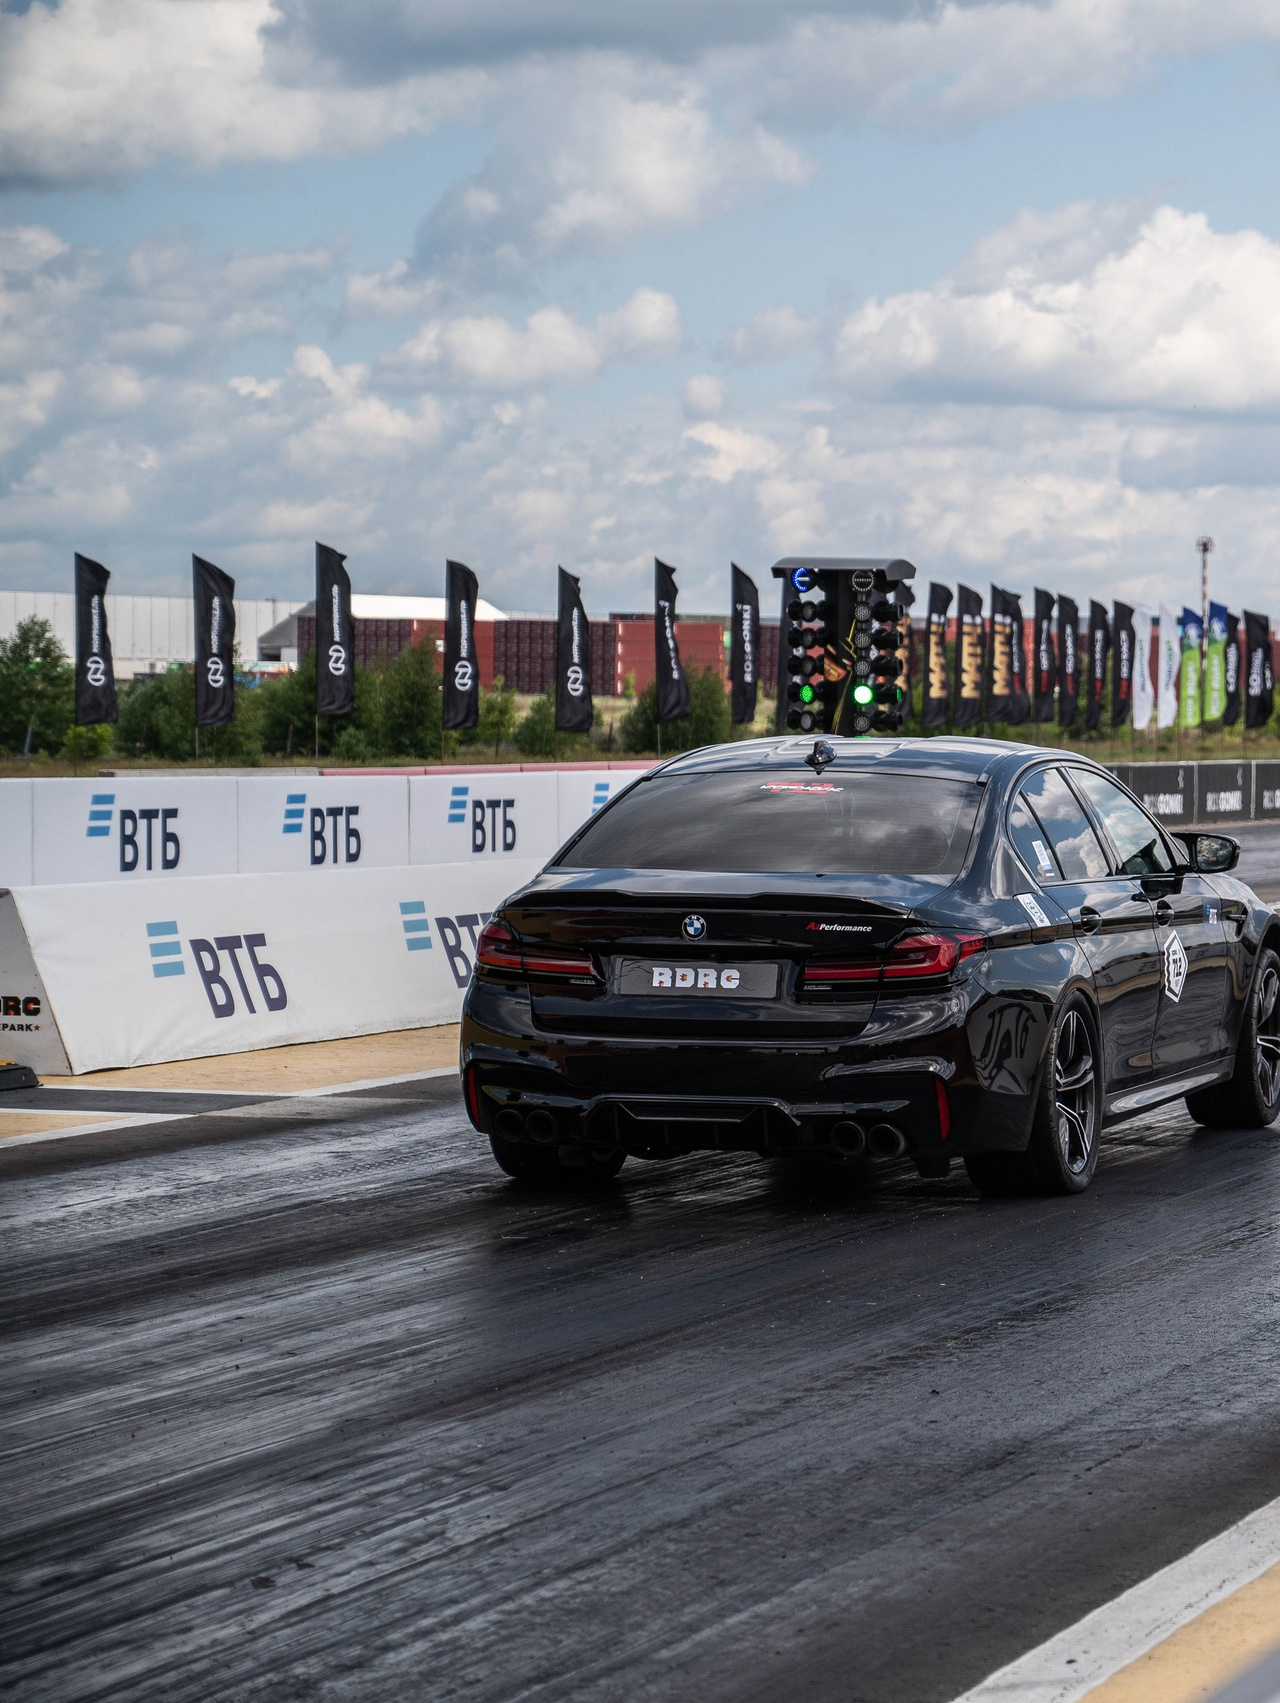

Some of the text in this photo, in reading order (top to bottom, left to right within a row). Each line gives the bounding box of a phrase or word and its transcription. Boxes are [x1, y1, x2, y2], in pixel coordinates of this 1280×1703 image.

[119, 807, 181, 872] ВТБ
[310, 805, 362, 866] ВТБ
[471, 798, 517, 853] ВТБ
[189, 932, 289, 1019] ВТБ
[434, 912, 497, 989] ВТ
[652, 967, 741, 989] RDRC
